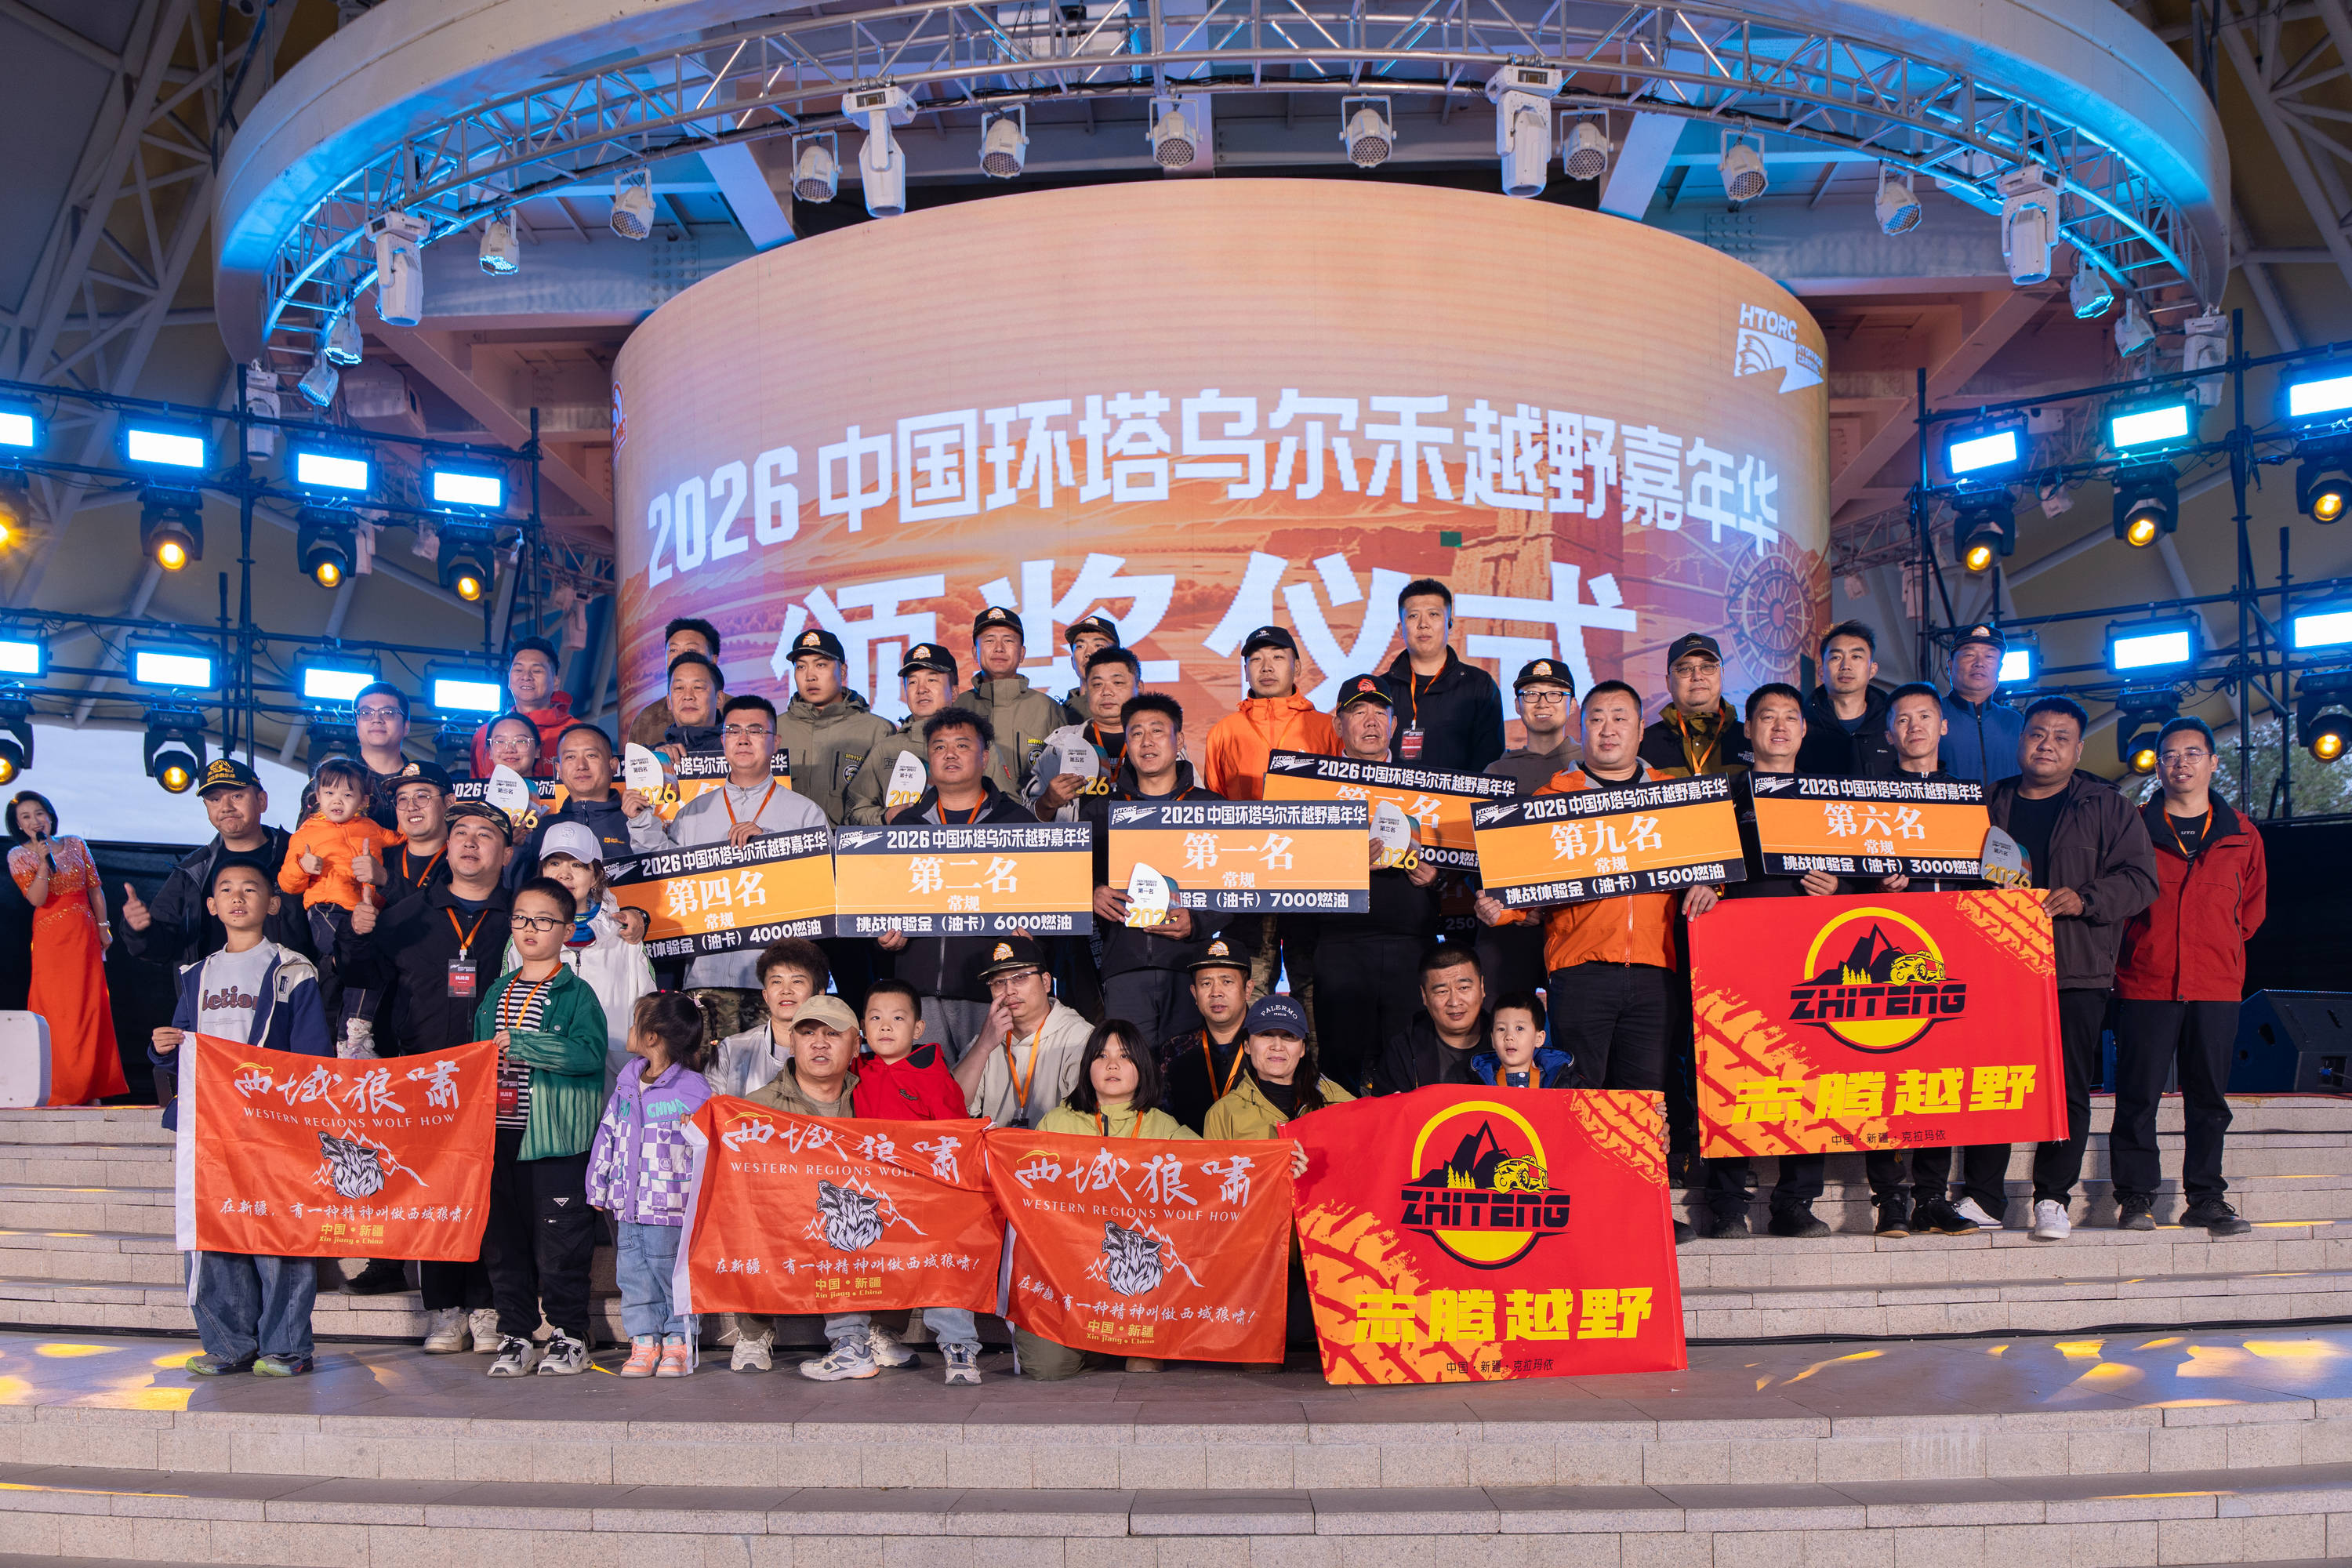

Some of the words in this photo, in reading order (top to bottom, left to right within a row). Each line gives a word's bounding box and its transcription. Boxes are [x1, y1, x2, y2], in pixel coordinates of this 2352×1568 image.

[1739, 303, 1798, 342] HTORC
[648, 445, 799, 588] 2026
[818, 388, 1779, 557] 中国环塔乌尔禾越野嘉年华
[770, 551, 1637, 728] 颁奖仪式
[1076, 776, 1109, 795] 26
[1317, 759, 1359, 779] 2026
[1362, 764, 1516, 797] 中国环塔乌尔禾越野嘉年华
[1798, 778, 1839, 796] 2026
[1840, 779, 1983, 800] 中国环塔乌尔禾越野嘉年华
[453, 783, 481, 797] 026
[633, 783, 677, 805] 026
[888, 790, 922, 807] 202
[1523, 798, 1568, 820] 2026
[1568, 778, 1728, 815] 中国环塔乌尔禾越野嘉年华
[1161, 806, 1204, 824] 2026
[1207, 805, 1367, 825] 中国环塔乌尔禾越野嘉年华
[1475, 805, 1498, 815] HTORC
[1824, 803, 1926, 839] 第六名
[887, 830, 930, 849] 2026
[932, 827, 1090, 848] 中国环塔乌尔禾越野嘉年华
[1550, 815, 1663, 860] 第九名
[1864, 839, 1896, 855] 常规
[641, 854, 681, 877] 2026
[682, 831, 828, 870] 中国环塔乌尔禾越野嘉年华
[1182, 832, 1294, 870] 第一名
[1373, 847, 1418, 870] 026
[604, 862, 619, 872] TORC
[1595, 855, 1629, 873] 常规
[908, 856, 1018, 895] 第二名
[1222, 871, 1256, 887] 常规
[1984, 863, 2032, 889] 2026
[666, 870, 766, 917] 第四名
[947, 895, 980, 911] 常规
[704, 912, 735, 930] 常规
[1127, 907, 1178, 927] 202
[1261, 1004, 1298, 1019] PALERMO
[1789, 984, 1966, 1019] ZHITENG
[1730, 1064, 2037, 1123] 志腾越野
[244, 1107, 299, 1124] WESTERN
[306, 1117, 365, 1128] REGIONS
[372, 1118, 412, 1128] WOLF
[421, 1114, 455, 1126] HOW
[647, 1098, 690, 1118] CHINA
[731, 1162, 797, 1174] WESTERN
[806, 1164, 871, 1177] REGIONS
[1022, 1198, 1086, 1214] WESTERN
[1093, 1205, 1156, 1218] REGIONS
[1163, 1209, 1203, 1221] WOLF
[1210, 1211, 1240, 1221] HOW
[1401, 1189, 1570, 1228] ZHITENG
[1353, 1287, 1653, 1343] 志腾越野
